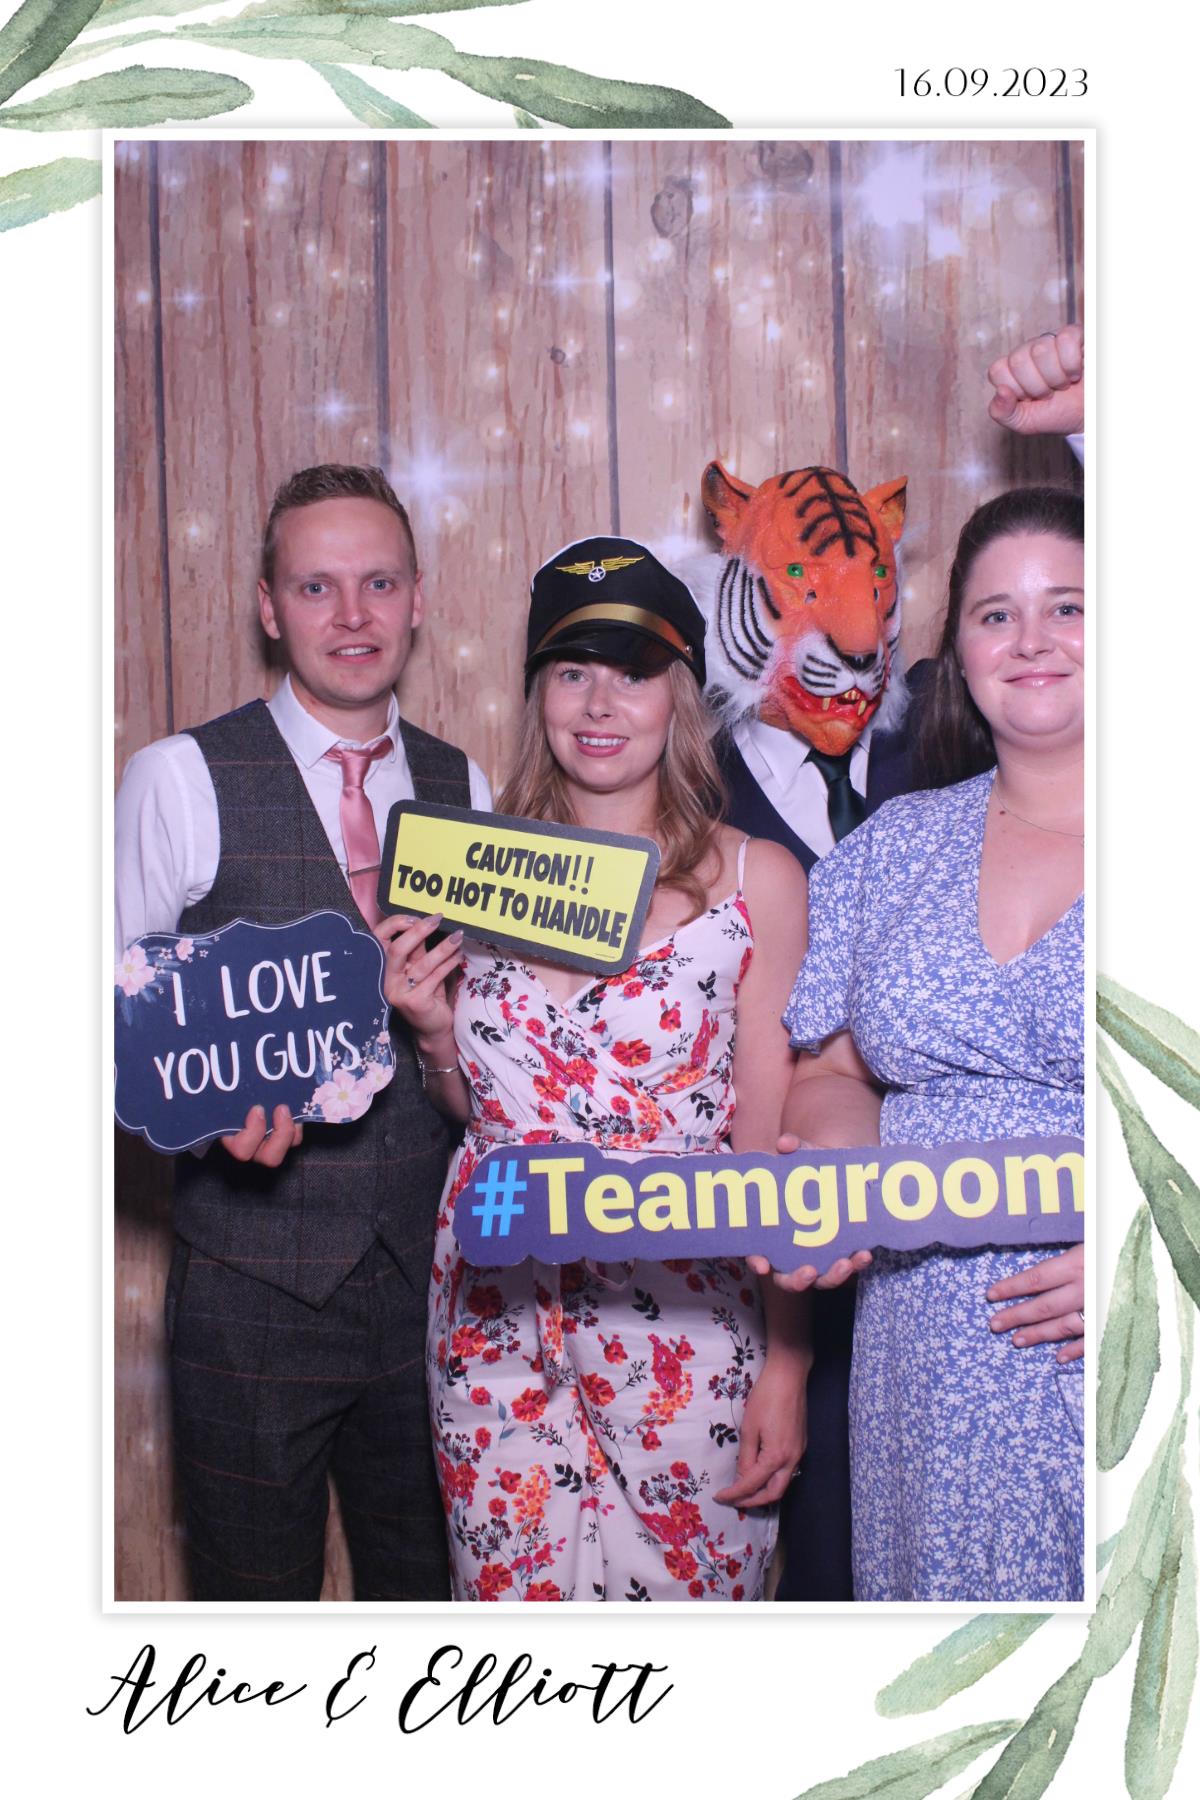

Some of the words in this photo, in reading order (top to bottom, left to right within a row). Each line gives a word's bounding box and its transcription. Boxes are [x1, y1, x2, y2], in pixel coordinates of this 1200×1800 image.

[397, 864, 443, 898] TOO
[445, 876, 496, 912] HOT
[499, 886, 530, 921] TO
[531, 895, 628, 949] HANDLE
[465, 841, 595, 895] CAUTION!!
[172, 972, 187, 1026] I
[220, 951, 337, 1019] LOVE
[153, 1041, 240, 1100] YOU
[255, 1021, 361, 1081] GUYS
[471, 1151, 1085, 1248] #Teamgroom
